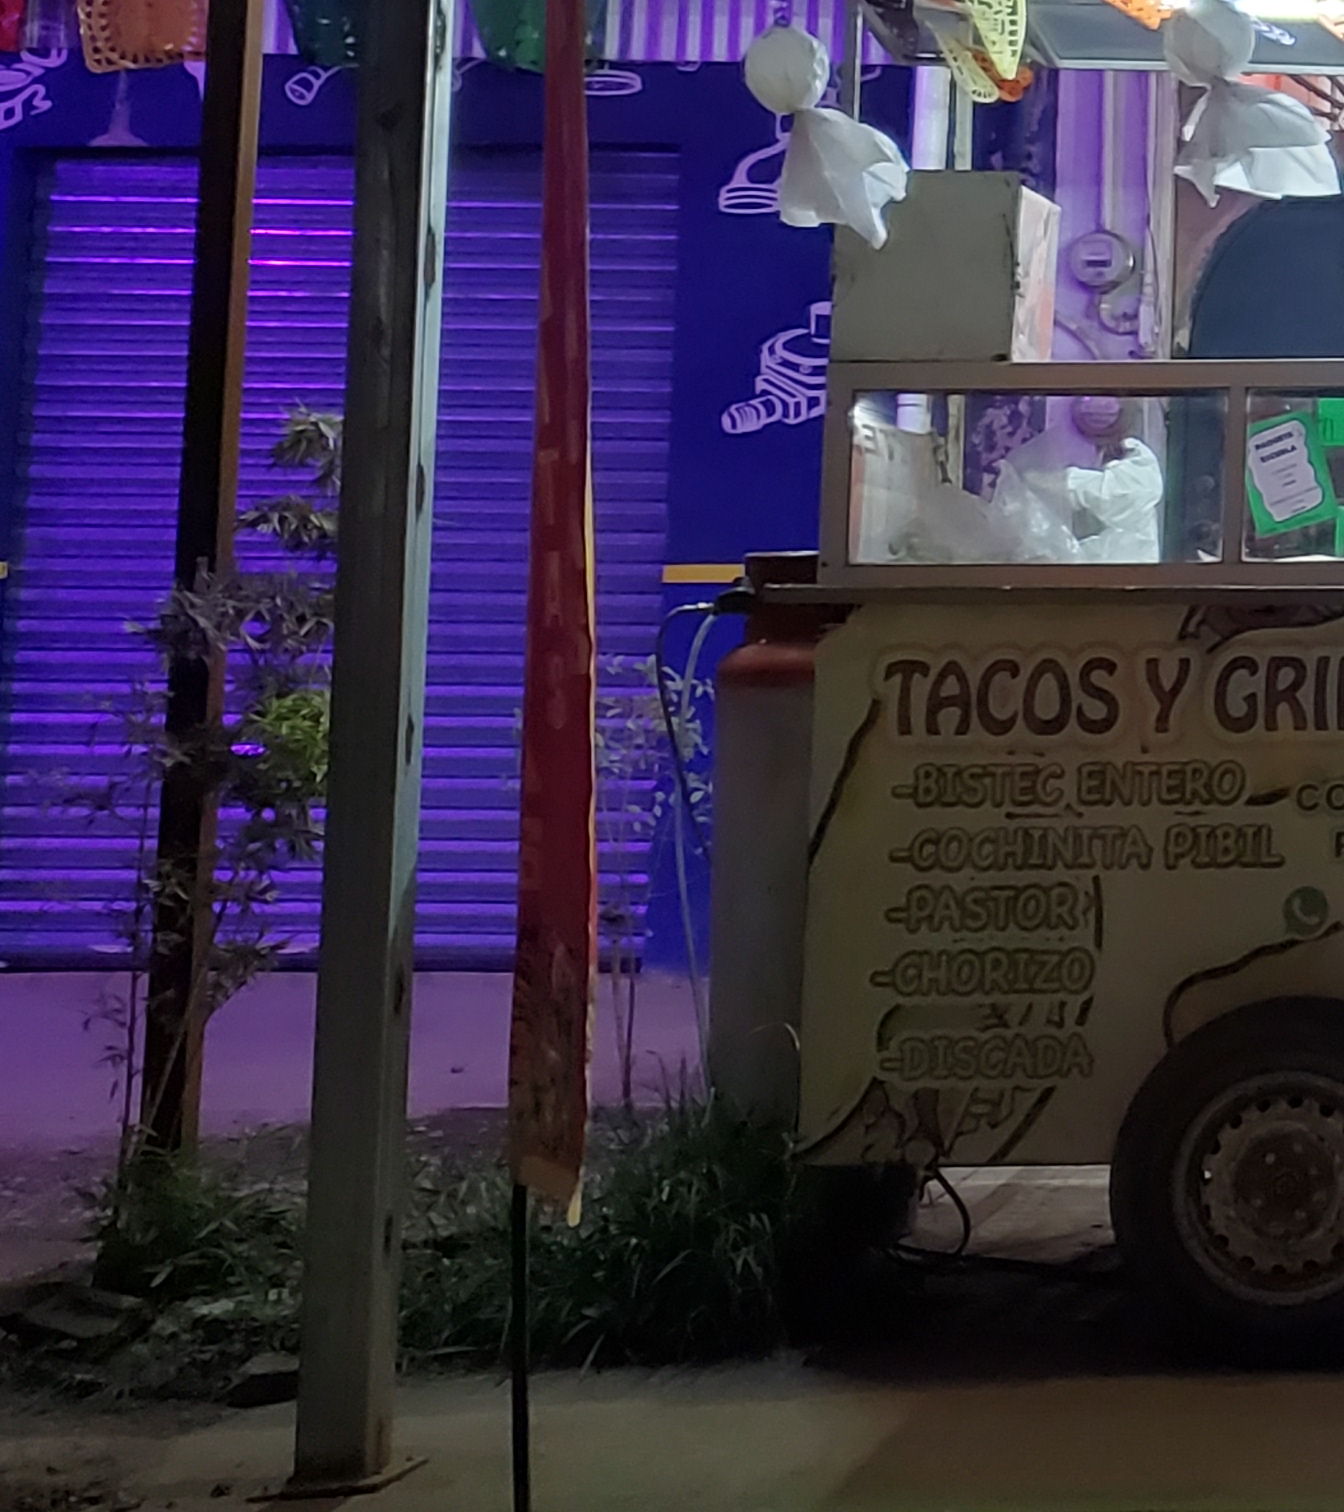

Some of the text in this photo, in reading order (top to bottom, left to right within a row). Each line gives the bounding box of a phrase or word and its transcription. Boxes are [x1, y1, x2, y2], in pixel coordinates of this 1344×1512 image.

[882, 656, 1120, 737] TACOS
[1145, 656, 1191, 734] Y
[1077, 759, 1246, 807] ENTERO
[1164, 823, 1286, 870] PIBIL
